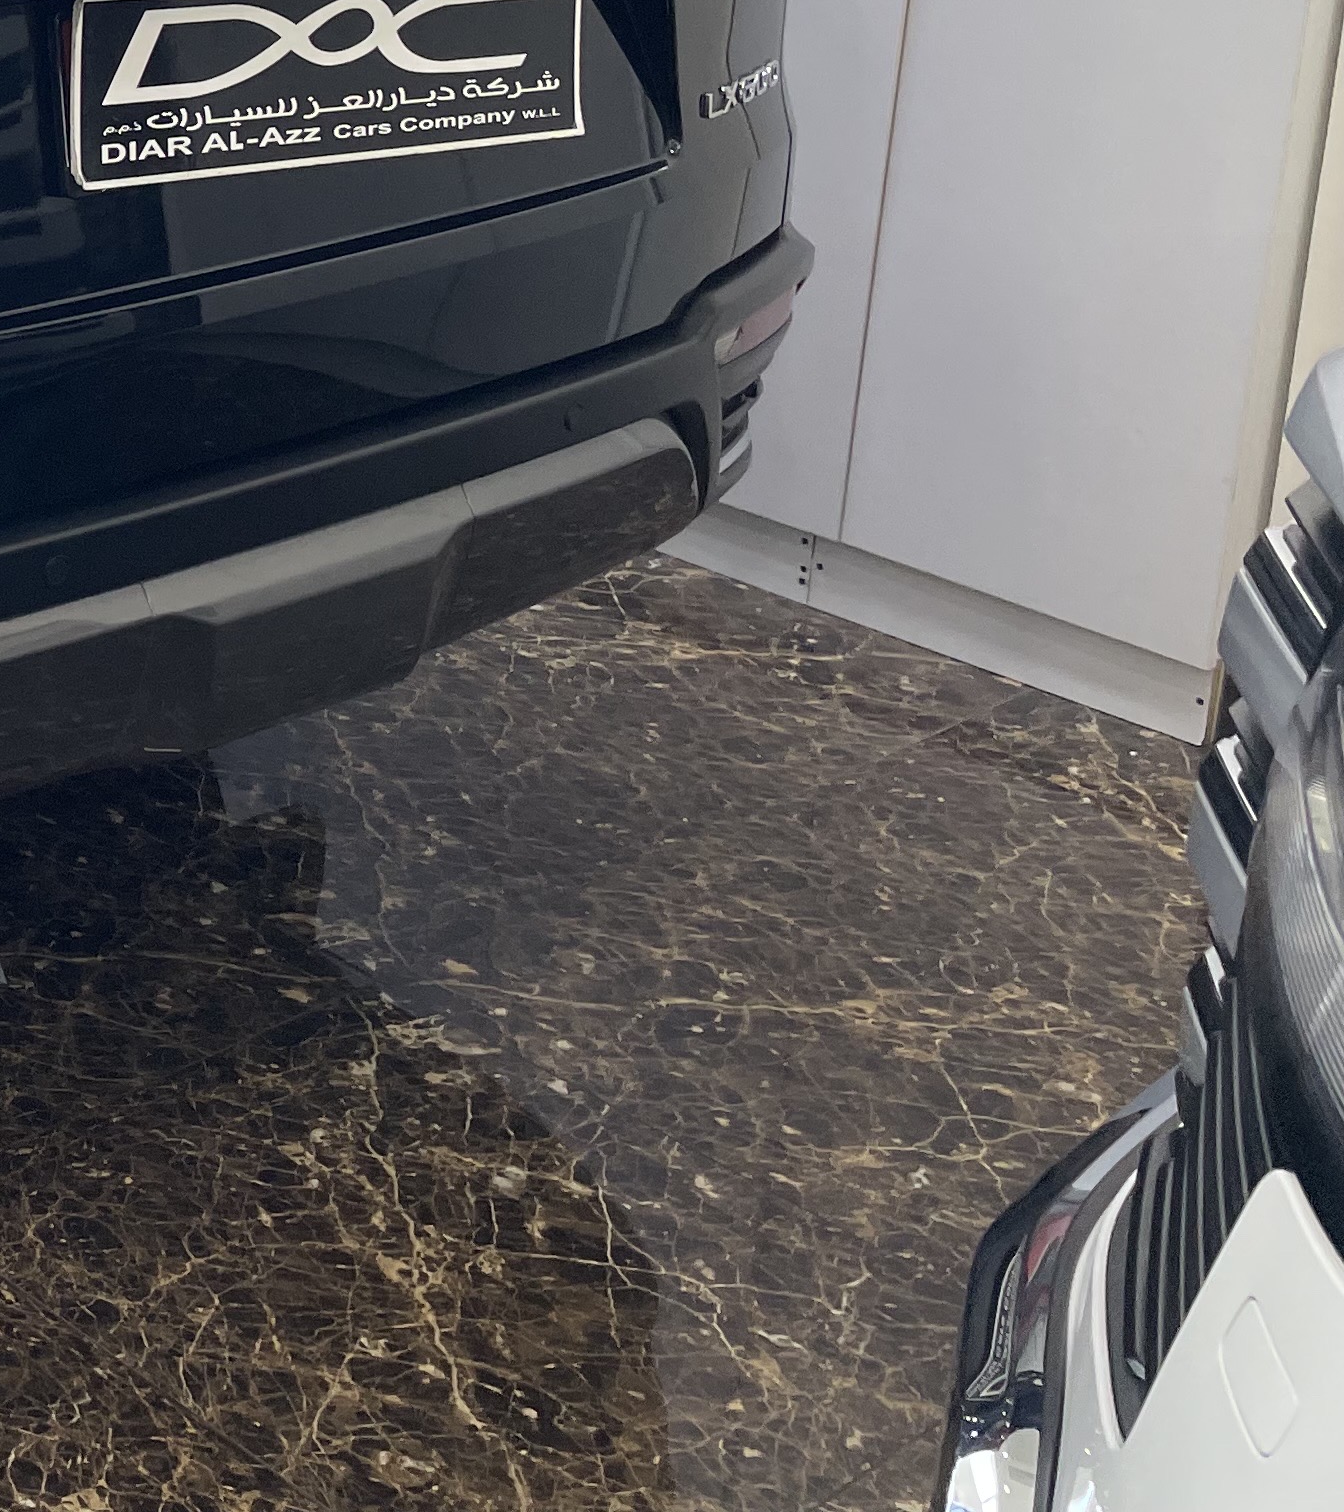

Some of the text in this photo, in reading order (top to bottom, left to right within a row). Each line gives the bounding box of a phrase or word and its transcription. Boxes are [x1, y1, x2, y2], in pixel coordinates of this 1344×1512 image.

[462, 70, 561, 100] شركة
[145, 95, 299, 132] للسيارات
[100, 135, 194, 165] DIAR
[333, 121, 393, 139] Cars
[399, 108, 516, 133] Company
